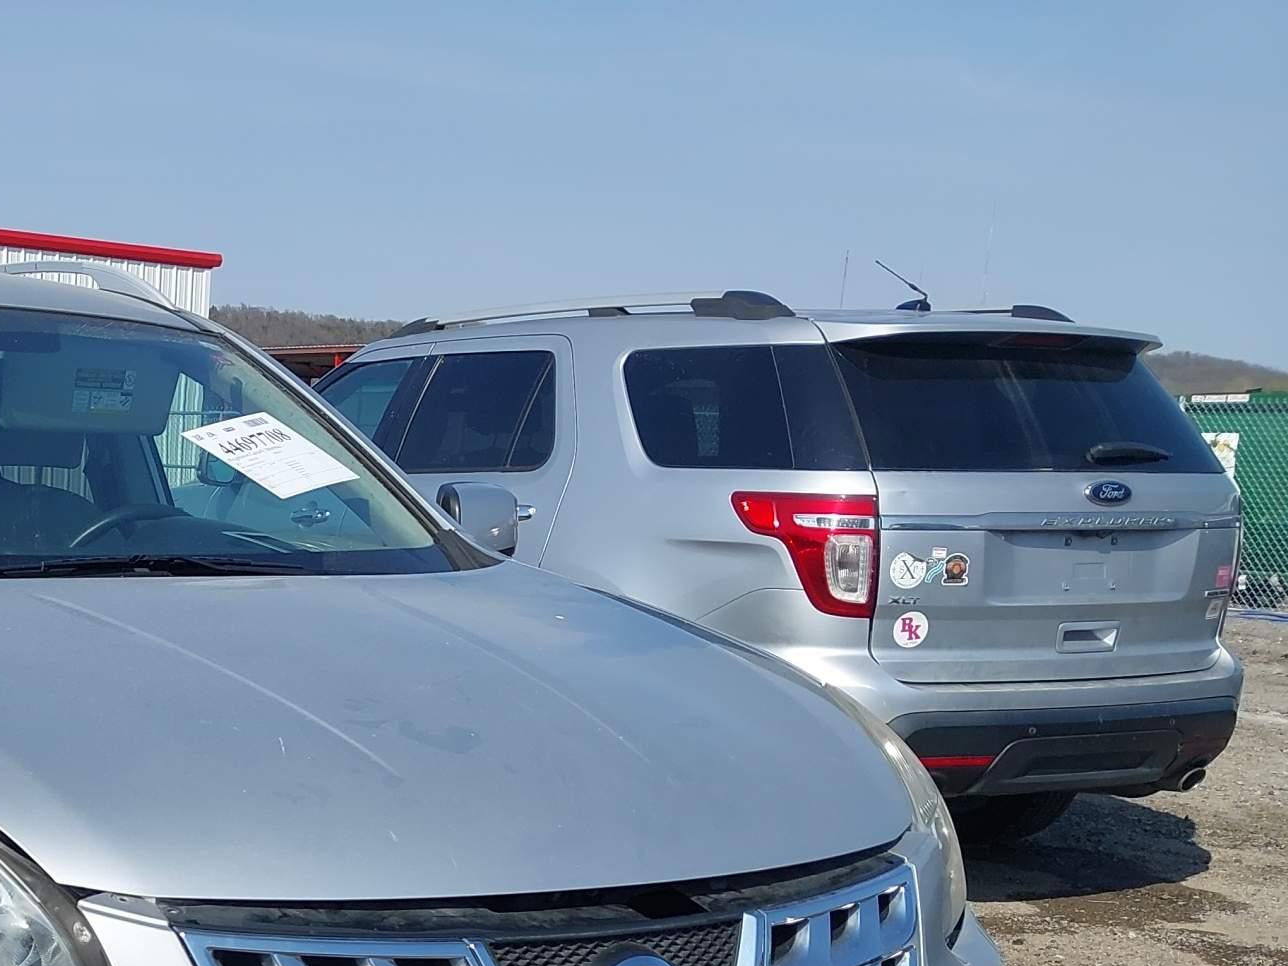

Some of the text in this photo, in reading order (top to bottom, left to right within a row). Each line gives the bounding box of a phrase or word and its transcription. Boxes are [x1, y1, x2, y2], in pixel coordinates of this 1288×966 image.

[218, 428, 292, 455] 44697708
[1099, 483, 1126, 500] Ford
[1039, 515, 1177, 529] EXPLORER
[888, 596, 921, 606] XLT
